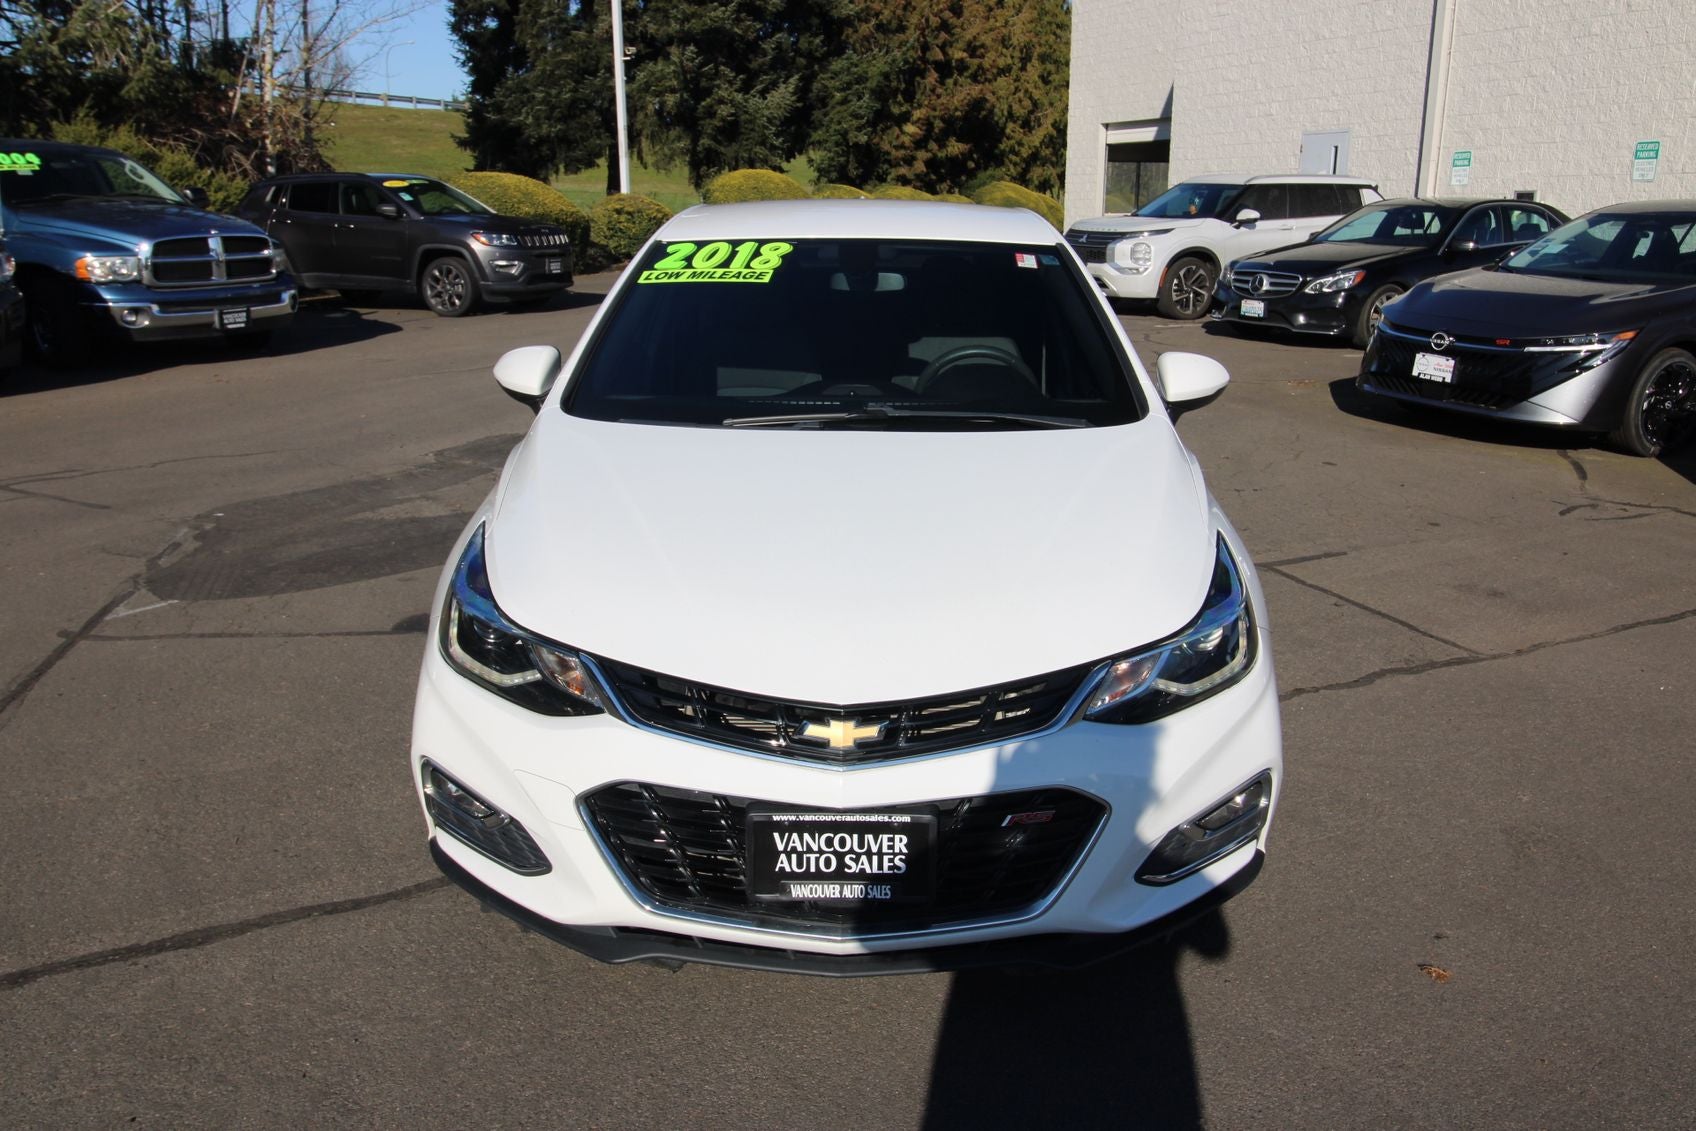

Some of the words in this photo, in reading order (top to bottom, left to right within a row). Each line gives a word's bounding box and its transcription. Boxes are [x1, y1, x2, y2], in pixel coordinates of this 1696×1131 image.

[1636, 150, 1657, 158] PARKING
[654, 241, 793, 270] 2018
[643, 271, 685, 281] LOW
[686, 270, 770, 281] MILEAGE
[772, 814, 911, 823] www.vancouverautosales.com
[773, 832, 908, 853] VANCOUVER
[775, 853, 837, 873] AUTO
[844, 854, 907, 874] SALES
[790, 884, 841, 898] VANCOUVER
[842, 884, 866, 898] AUTO
[867, 885, 891, 899] SALES
